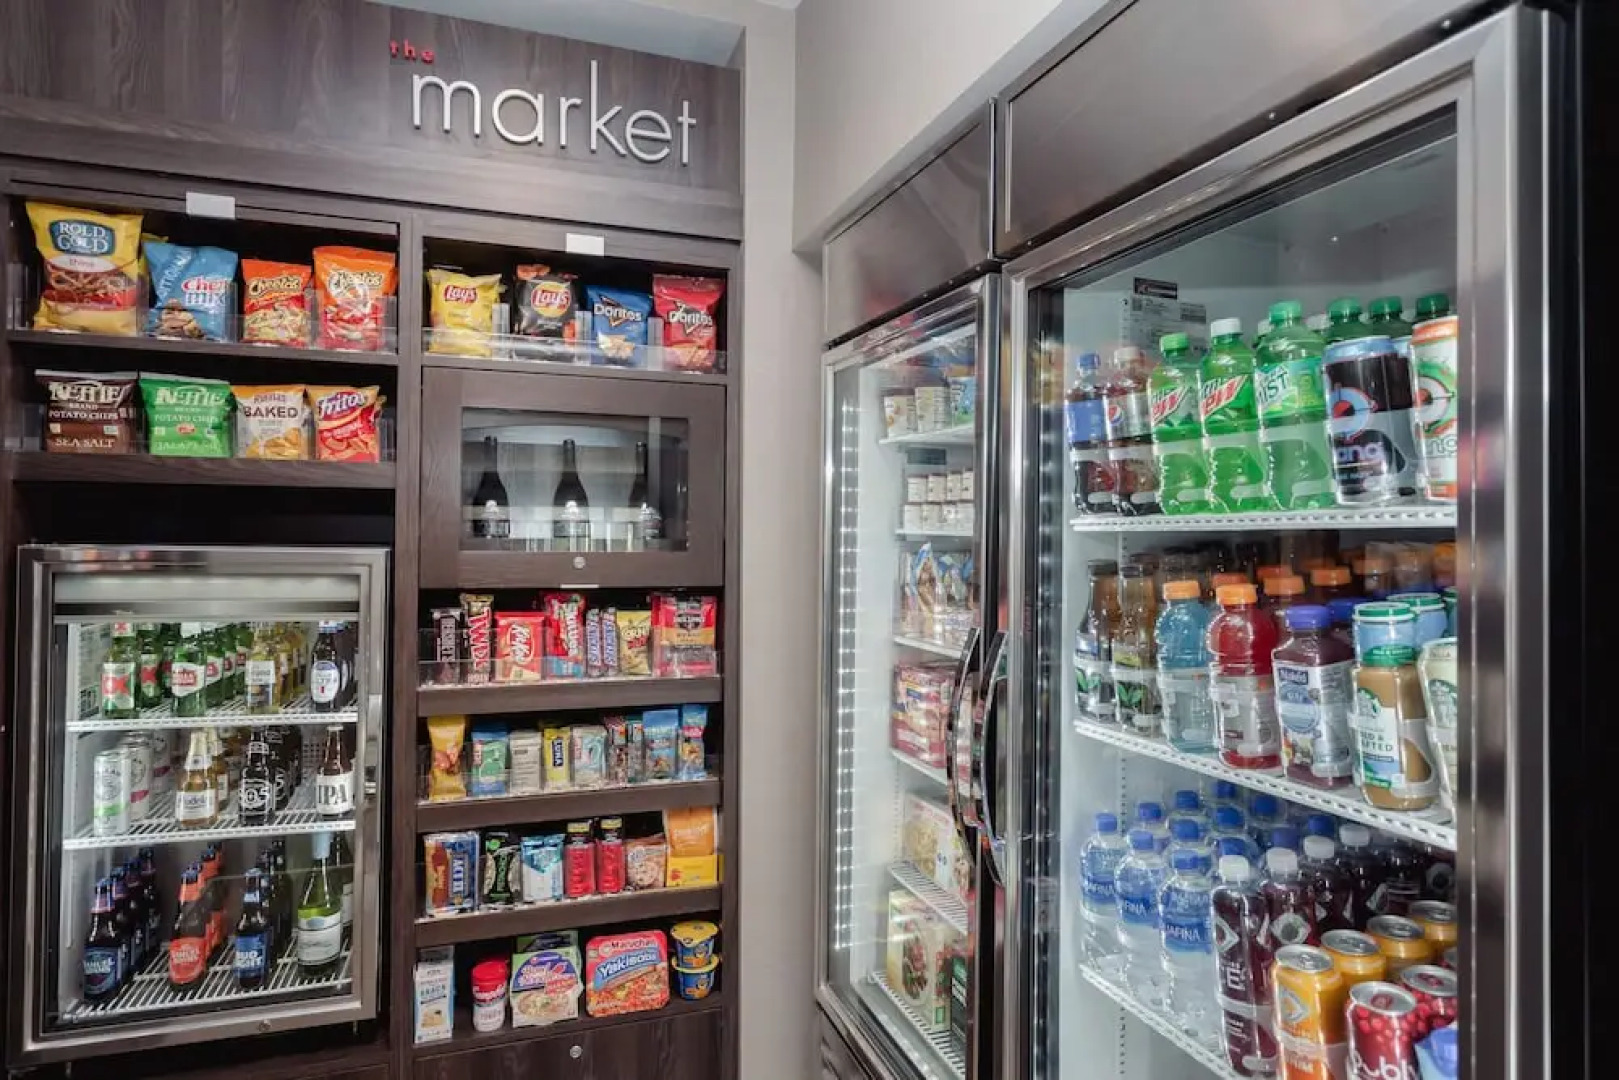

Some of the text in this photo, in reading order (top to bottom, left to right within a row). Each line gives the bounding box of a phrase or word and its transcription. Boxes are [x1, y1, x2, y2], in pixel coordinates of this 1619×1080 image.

[389, 38, 434, 64] the
[413, 59, 697, 168] market
[58, 221, 106, 238] ROLD
[57, 235, 109, 253] GOLD
[249, 274, 300, 296] Cheetos
[328, 268, 384, 298] Cheetos
[593, 302, 642, 322] Doritos
[668, 309, 713, 326] Doritos
[244, 405, 299, 419] BAKED
[316, 391, 366, 419] Fritos
[83, 438, 116, 449] SALT
[467, 606, 492, 671] TWIX
[318, 783, 348, 805] IPA
[599, 951, 658, 978] Yakisoba
